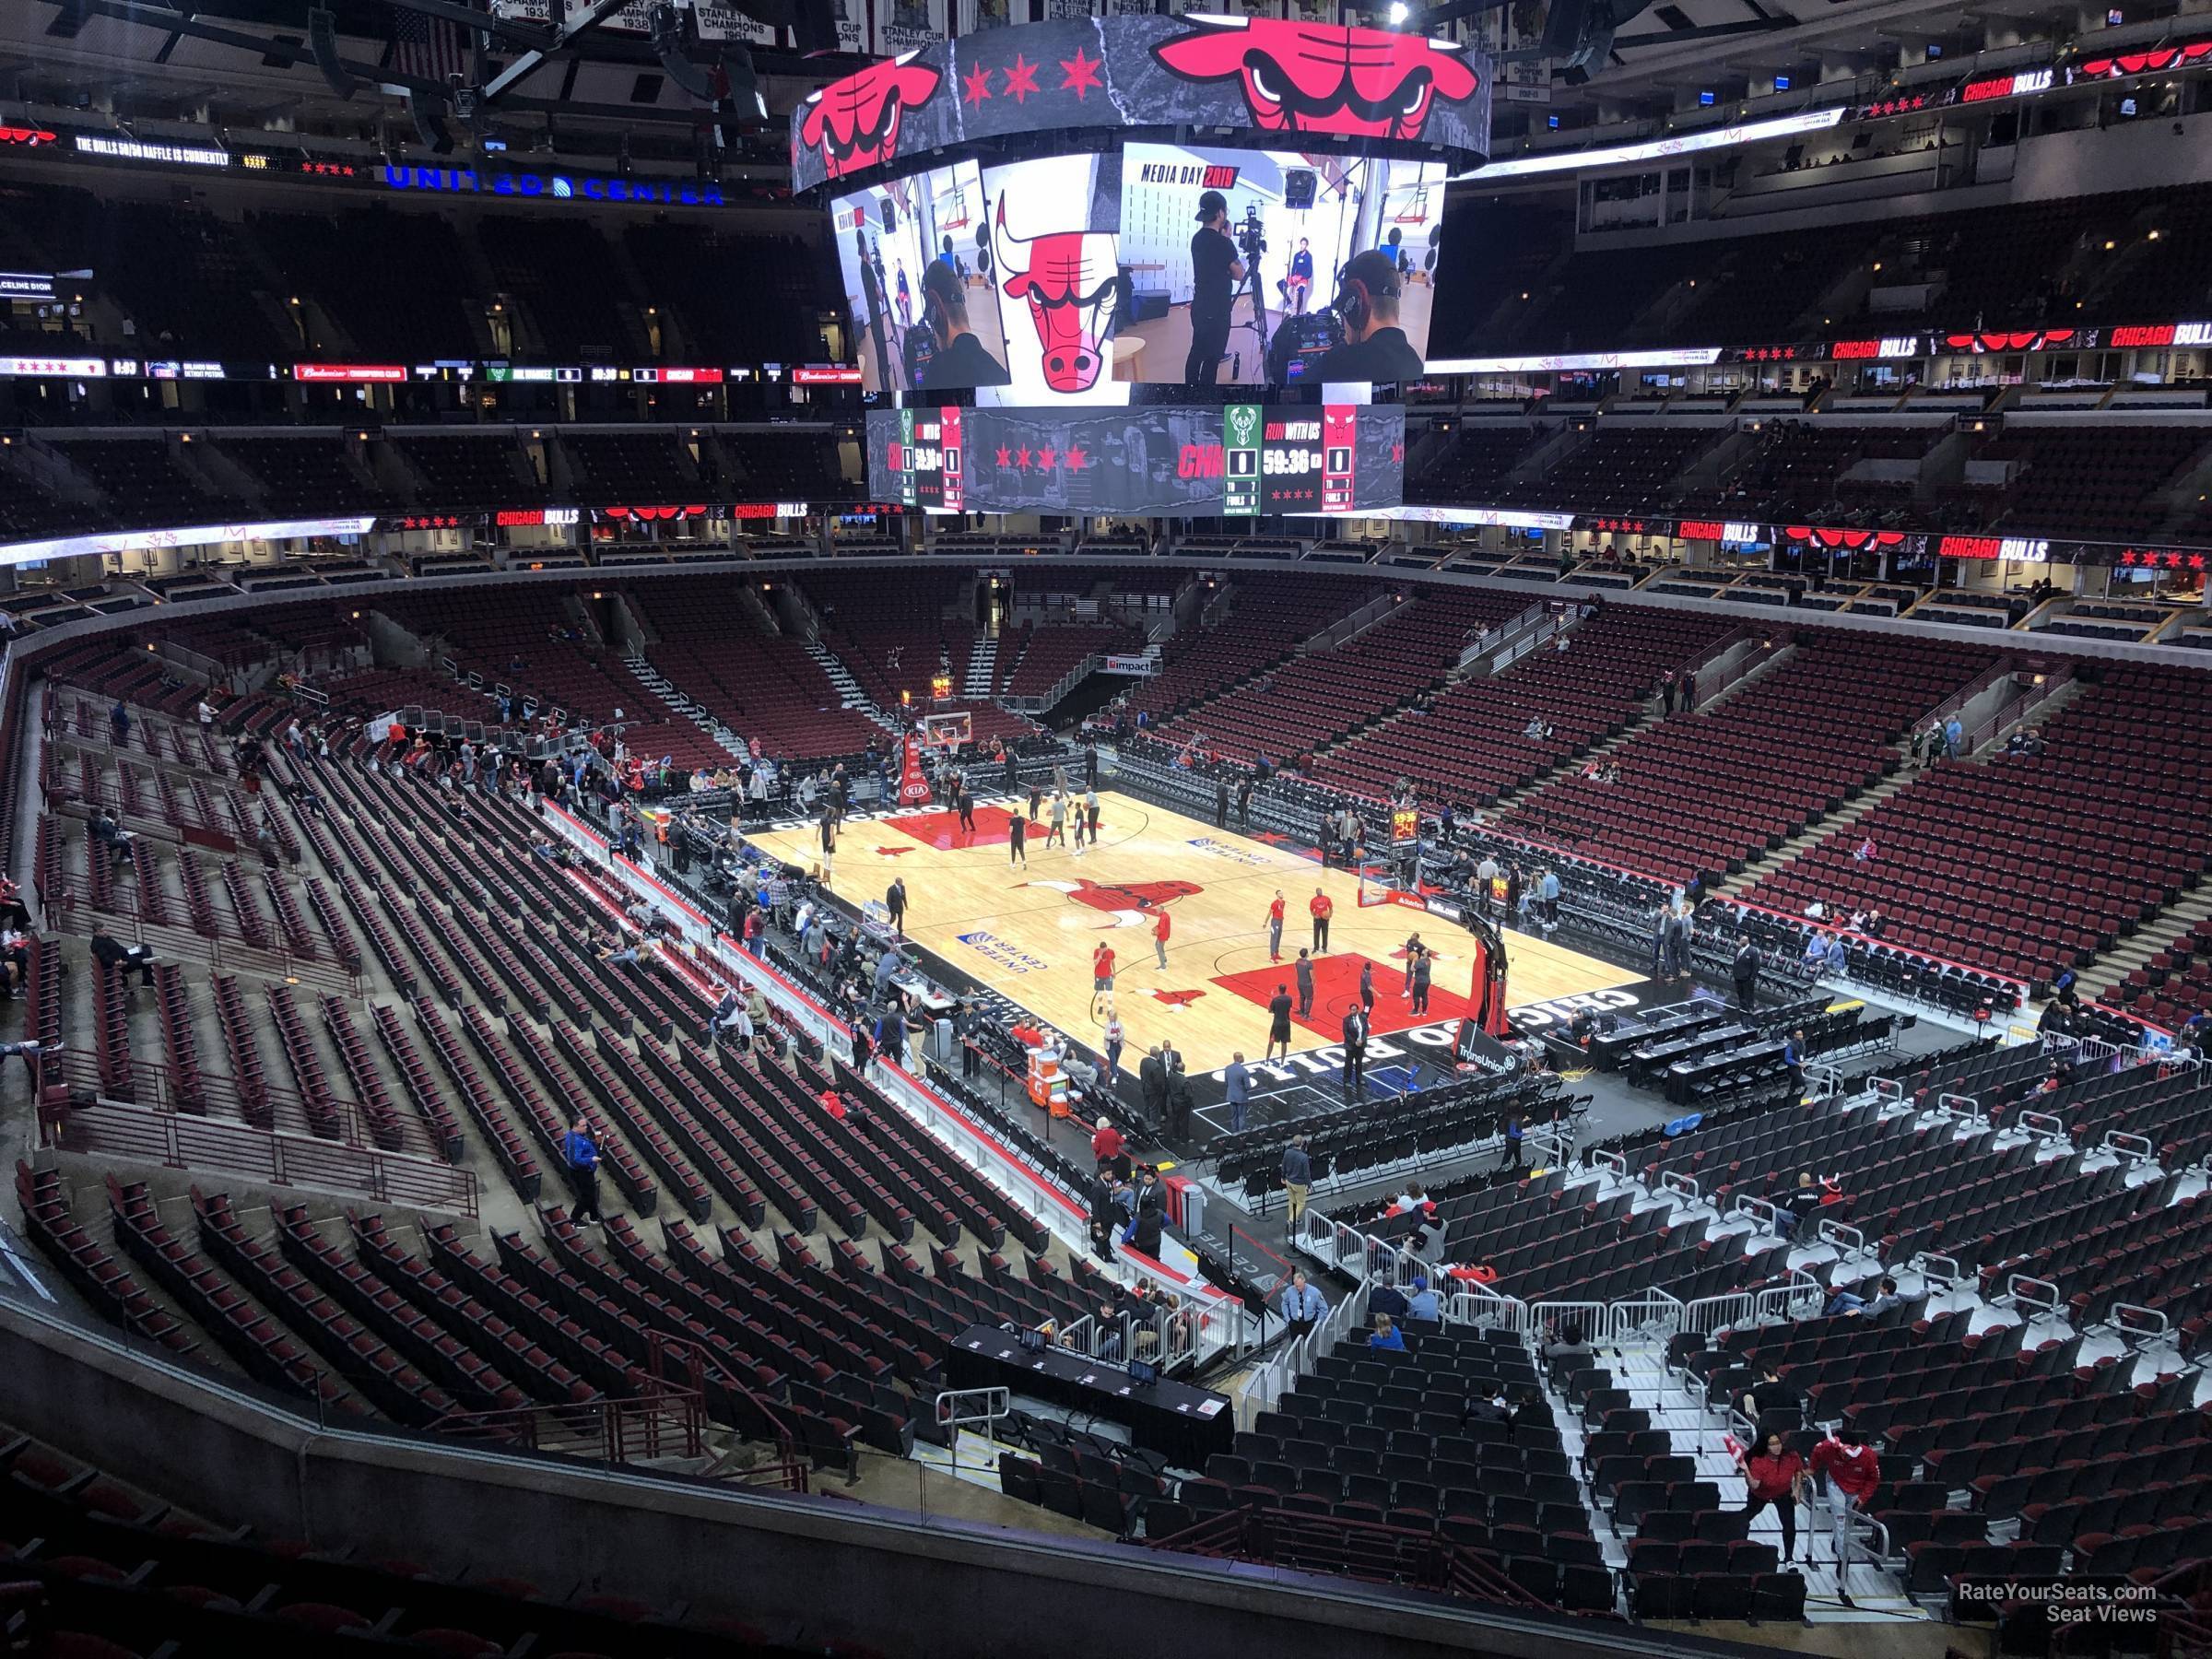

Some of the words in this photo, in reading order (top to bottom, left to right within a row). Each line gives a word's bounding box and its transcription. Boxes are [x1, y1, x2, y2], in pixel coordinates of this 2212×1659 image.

[699, 7, 741, 21] STANLEY
[1300, 14, 1326, 24] CHICAGO
[622, 18, 649, 29] 1938
[703, 18, 765, 34] CHAMPIONS
[841, 23, 862, 33] CUP
[881, 25, 921, 38] STANLEY
[924, 30, 945, 41] CUP
[1963, 77, 2014, 102] CHICAGO
[2013, 69, 2053, 94] BULLS
[76, 136, 92, 152] THE
[92, 138, 118, 155] BULLS
[118, 142, 142, 158] 50/50
[143, 144, 173, 161] RAFFLE
[173, 147, 182, 161] IS
[183, 148, 229, 166] CURRENTLY
[1141, 164, 1177, 184] MEDIA
[1181, 166, 1203, 185] DAY
[1204, 167, 1234, 188] 2019
[385, 165, 544, 196] UNITED
[583, 178, 724, 206] CENTER
[1, 281, 29, 289] CELINE
[30, 283, 52, 291] DION
[2111, 325, 2174, 347] CHICAGO
[2173, 324, 2212, 345] BULL
[1832, 340, 1878, 359] CHICAGO
[1878, 337, 1916, 358] BULLS
[301, 367, 347, 378] Budweiser
[800, 371, 839, 382] Budweiser
[1265, 422, 1286, 441] RUN
[1239, 453, 1247, 474] 0
[1263, 449, 1310, 475] 59:36
[1335, 451, 1343, 472] 0
[1226, 495, 1245, 507] FOULS
[497, 511, 544, 527] CHICAGO
[544, 509, 579, 524] BULLS
[735, 504, 776, 519] CHICAGO
[776, 503, 807, 517] BULLS
[1679, 522, 1724, 540] CHICAGO
[1723, 524, 1759, 543] BULLS
[1939, 536, 2000, 559] CHICAGO
[1998, 539, 2048, 563] BULLS
[1116, 660, 1150, 672] impact
[935, 686, 949, 698] 24
[908, 786, 924, 795] KIA
[1394, 812, 1417, 824] 59:36
[1395, 822, 1414, 839] 24
[974, 945, 1029, 975] UNITED
[994, 941, 1049, 971] CENTER
[1459, 1043, 1507, 1075] TransUnion
[1197, 1229, 1260, 1274] CENTE
